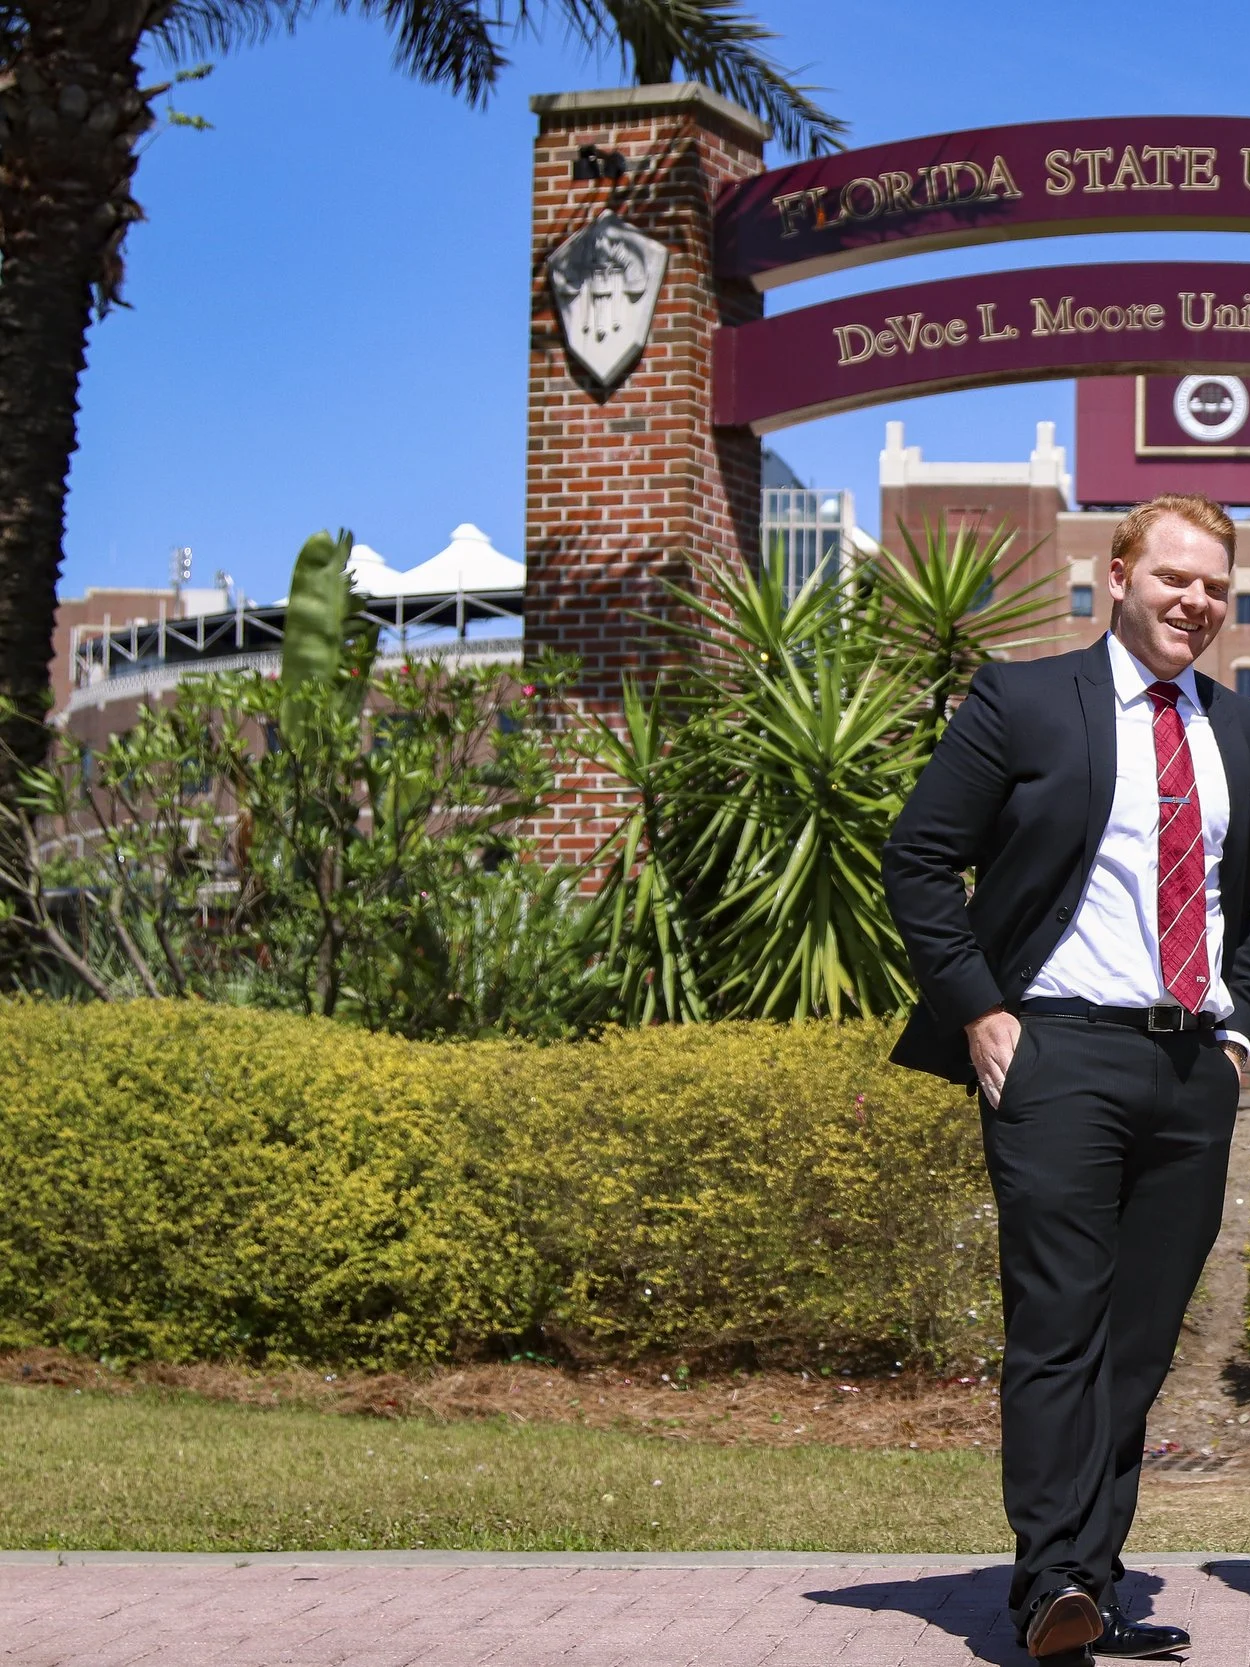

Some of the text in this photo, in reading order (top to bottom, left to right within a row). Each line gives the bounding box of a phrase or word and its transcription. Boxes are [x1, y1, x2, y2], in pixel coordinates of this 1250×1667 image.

[773, 155, 1023, 238] FLORIDA
[1045, 145, 1220, 196] STATE
[833, 313, 968, 366] DeVoe
[977, 303, 1019, 341] L.
[1030, 297, 1166, 337] Moore
